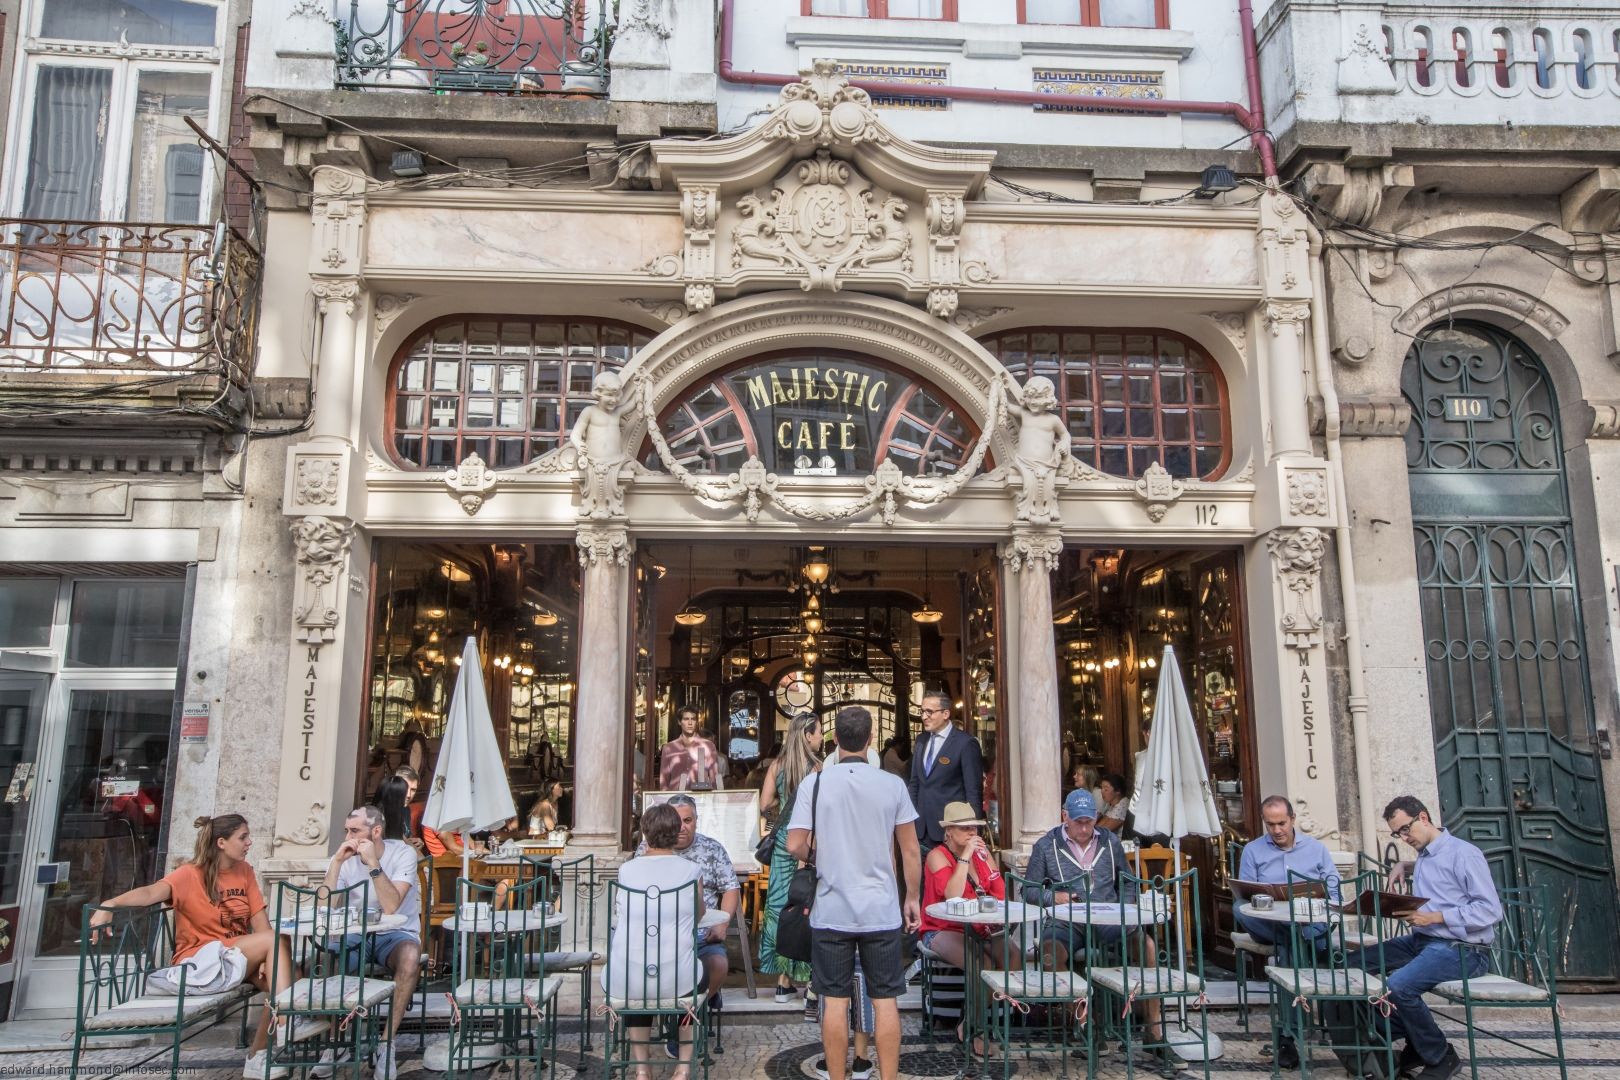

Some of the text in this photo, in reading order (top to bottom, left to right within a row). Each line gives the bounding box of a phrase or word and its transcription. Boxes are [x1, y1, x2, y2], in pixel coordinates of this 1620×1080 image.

[746, 367, 889, 413] MAJESTIC
[1453, 399, 1481, 416] 110
[777, 414, 856, 450] CAFÉ
[1195, 504, 1218, 526] 112
[299, 647, 321, 781] MAJESTIC
[1298, 652, 1318, 780] MAJESTIC
[226, 888, 247, 897] DREA
